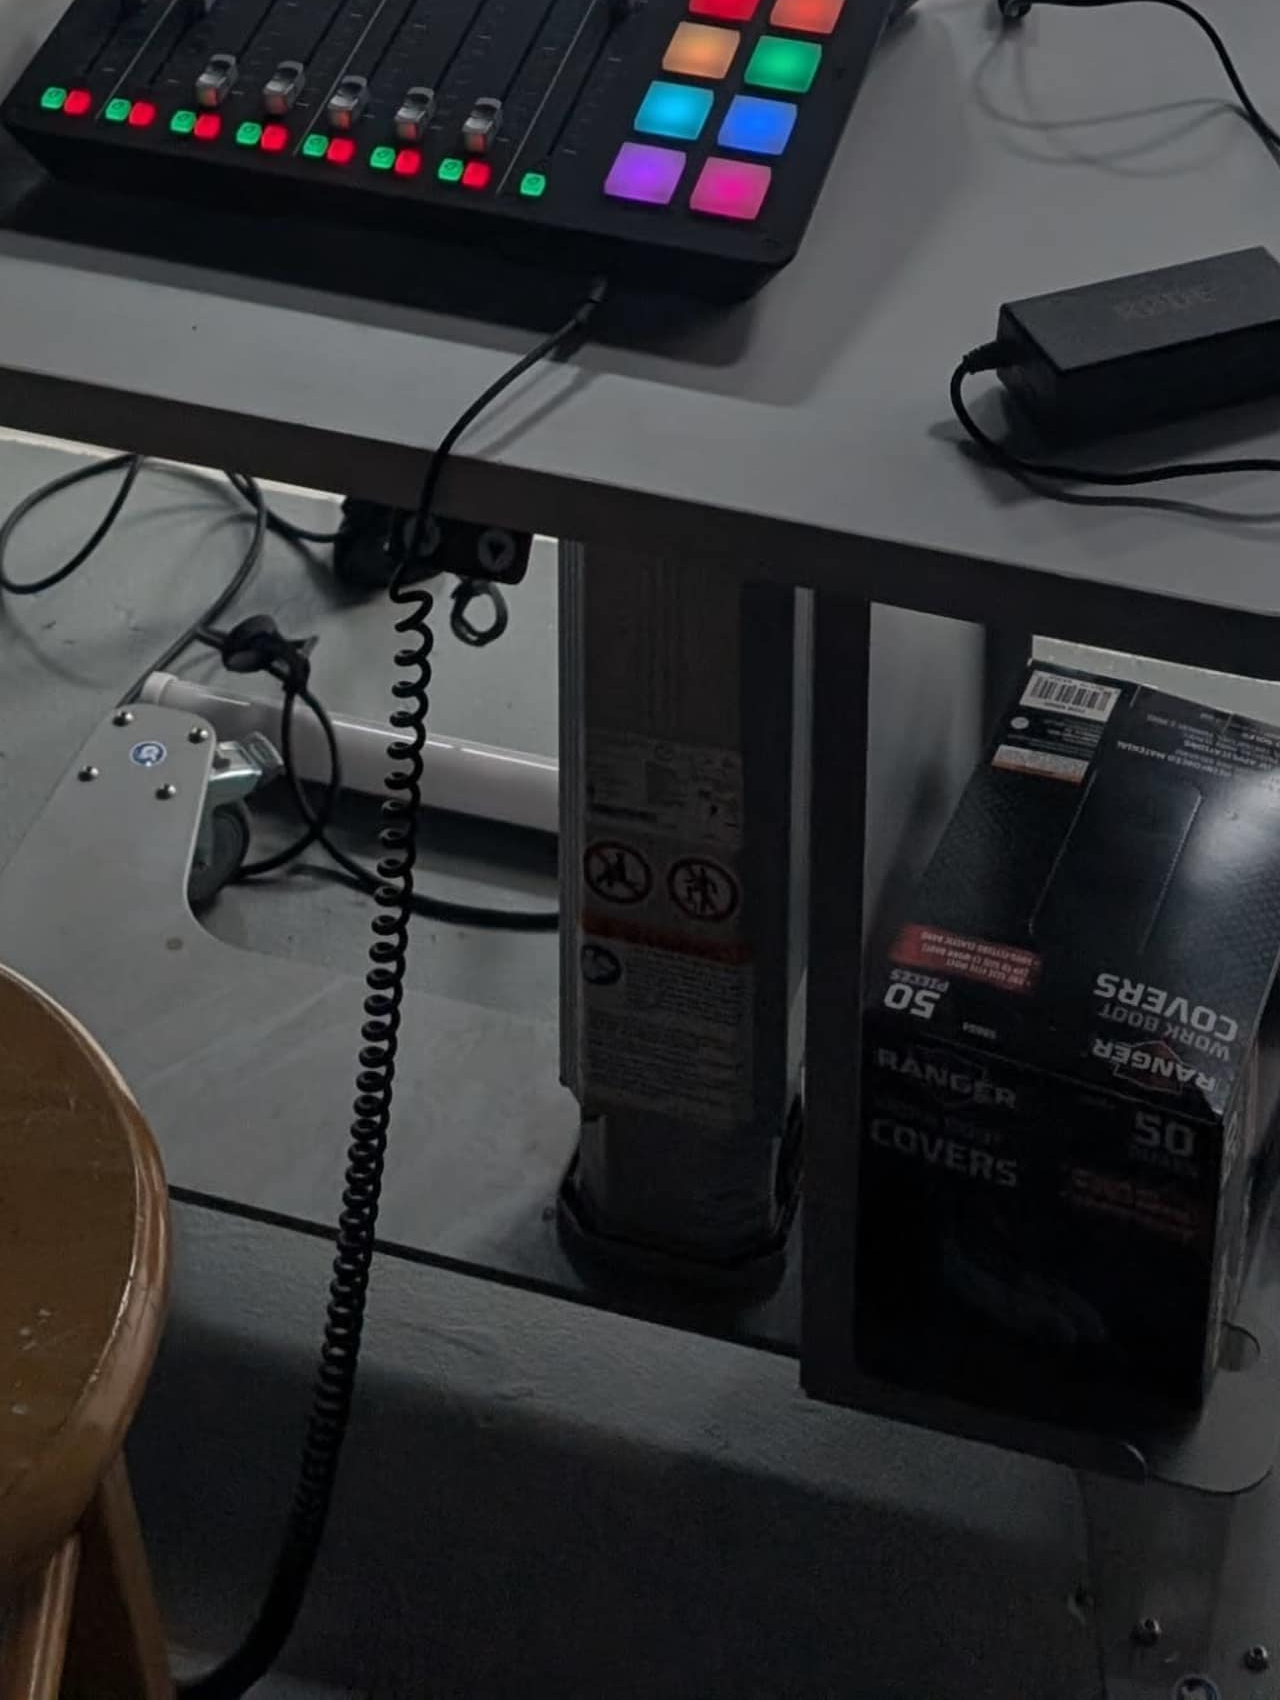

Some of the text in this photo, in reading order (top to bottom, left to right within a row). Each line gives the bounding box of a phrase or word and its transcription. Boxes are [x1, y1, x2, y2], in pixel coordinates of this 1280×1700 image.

[884, 983, 941, 1019] 50
[888, 968, 950, 993] PIECES
[1093, 972, 1238, 1042] COVERS
[1098, 1002, 1230, 1062] WORK BOOT
[874, 1047, 1018, 1109] RANGER
[1092, 1038, 1216, 1092] RANGER
[869, 1118, 1019, 1190] COVERS
[1131, 1110, 1198, 1157] 50
